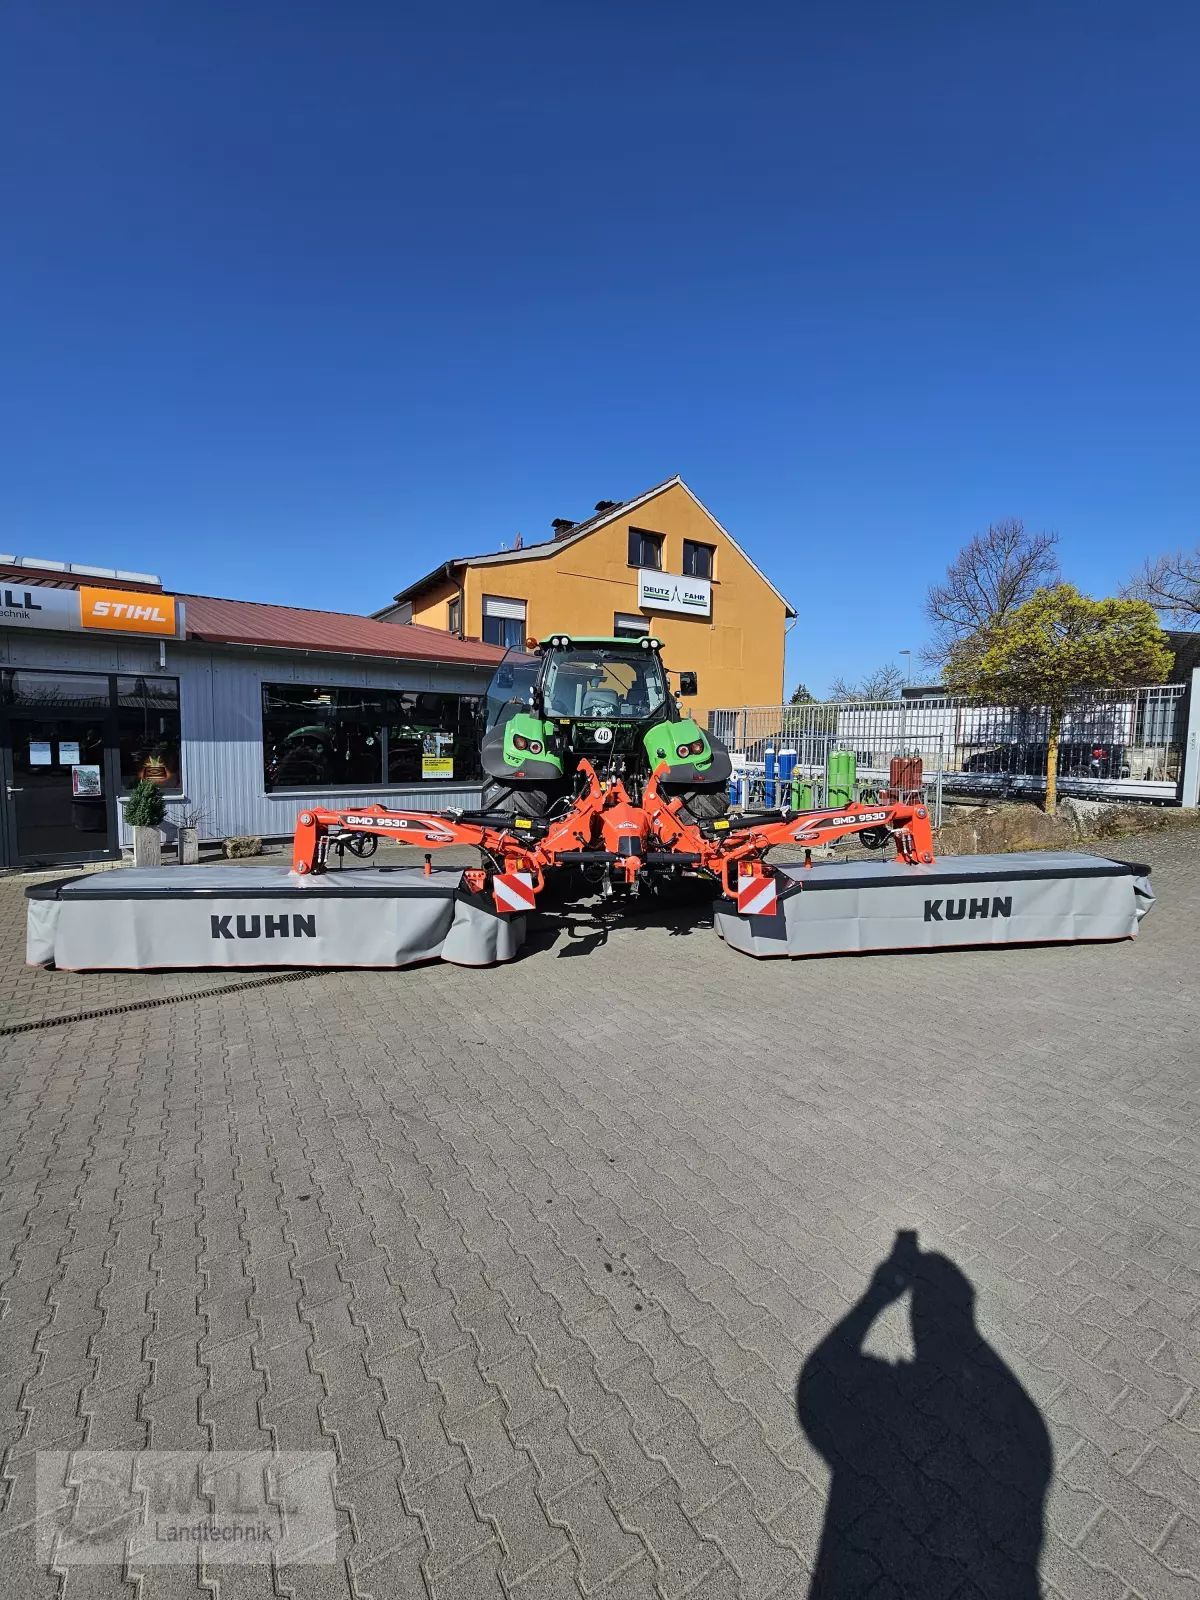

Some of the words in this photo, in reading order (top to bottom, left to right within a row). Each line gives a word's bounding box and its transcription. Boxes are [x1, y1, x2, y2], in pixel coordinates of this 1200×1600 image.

[0, 589, 42, 610] LL
[643, 585, 670, 596] DEUTZ
[684, 592, 706, 601] FAHR
[92, 601, 166, 622] STIHL
[597, 730, 609, 740] 40
[346, 816, 373, 825] GMD
[376, 818, 408, 828] 9530
[833, 816, 856, 825] GMD
[859, 812, 886, 822] 9530
[923, 896, 1013, 922] KUHN
[210, 913, 317, 939] KUHN
